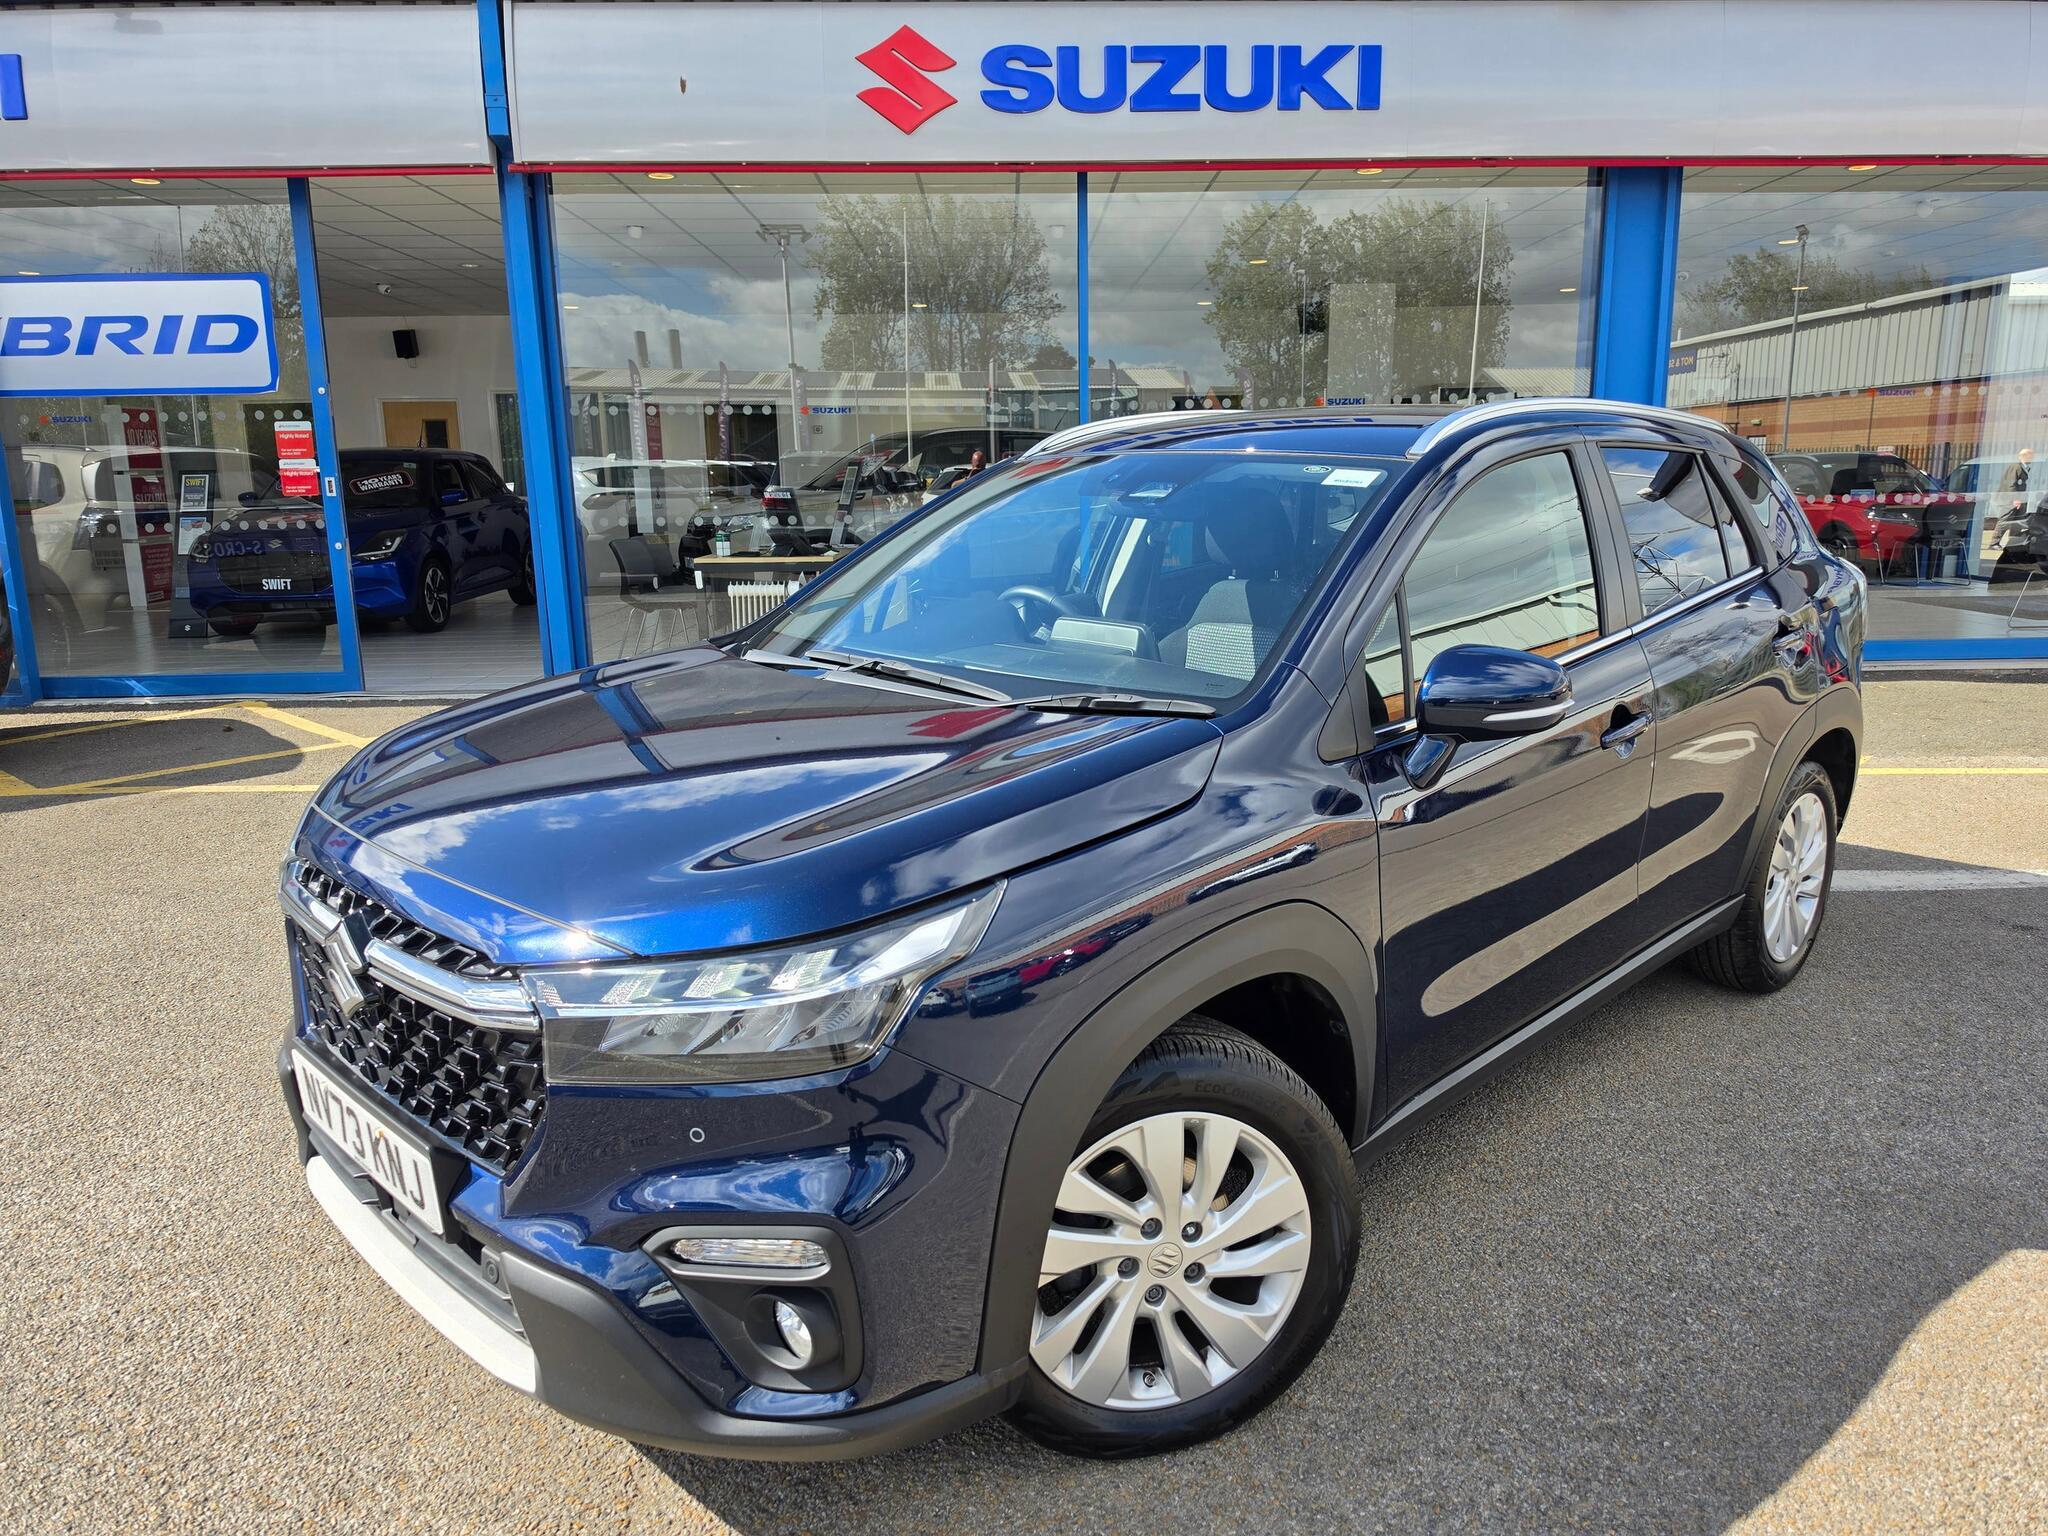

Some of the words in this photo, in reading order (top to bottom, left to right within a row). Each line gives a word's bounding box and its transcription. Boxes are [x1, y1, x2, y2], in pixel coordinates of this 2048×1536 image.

[980, 44, 1382, 113] SUZUKI
[0, 315, 259, 356] BRID
[1879, 388, 1916, 397] SUZUKI
[1327, 397, 1366, 405] SUZUKI
[185, 478, 205, 486] SWIFT
[262, 578, 291, 590] SWIFT
[302, 1065, 367, 1160] NV73
[367, 1121, 426, 1211] KNJ
